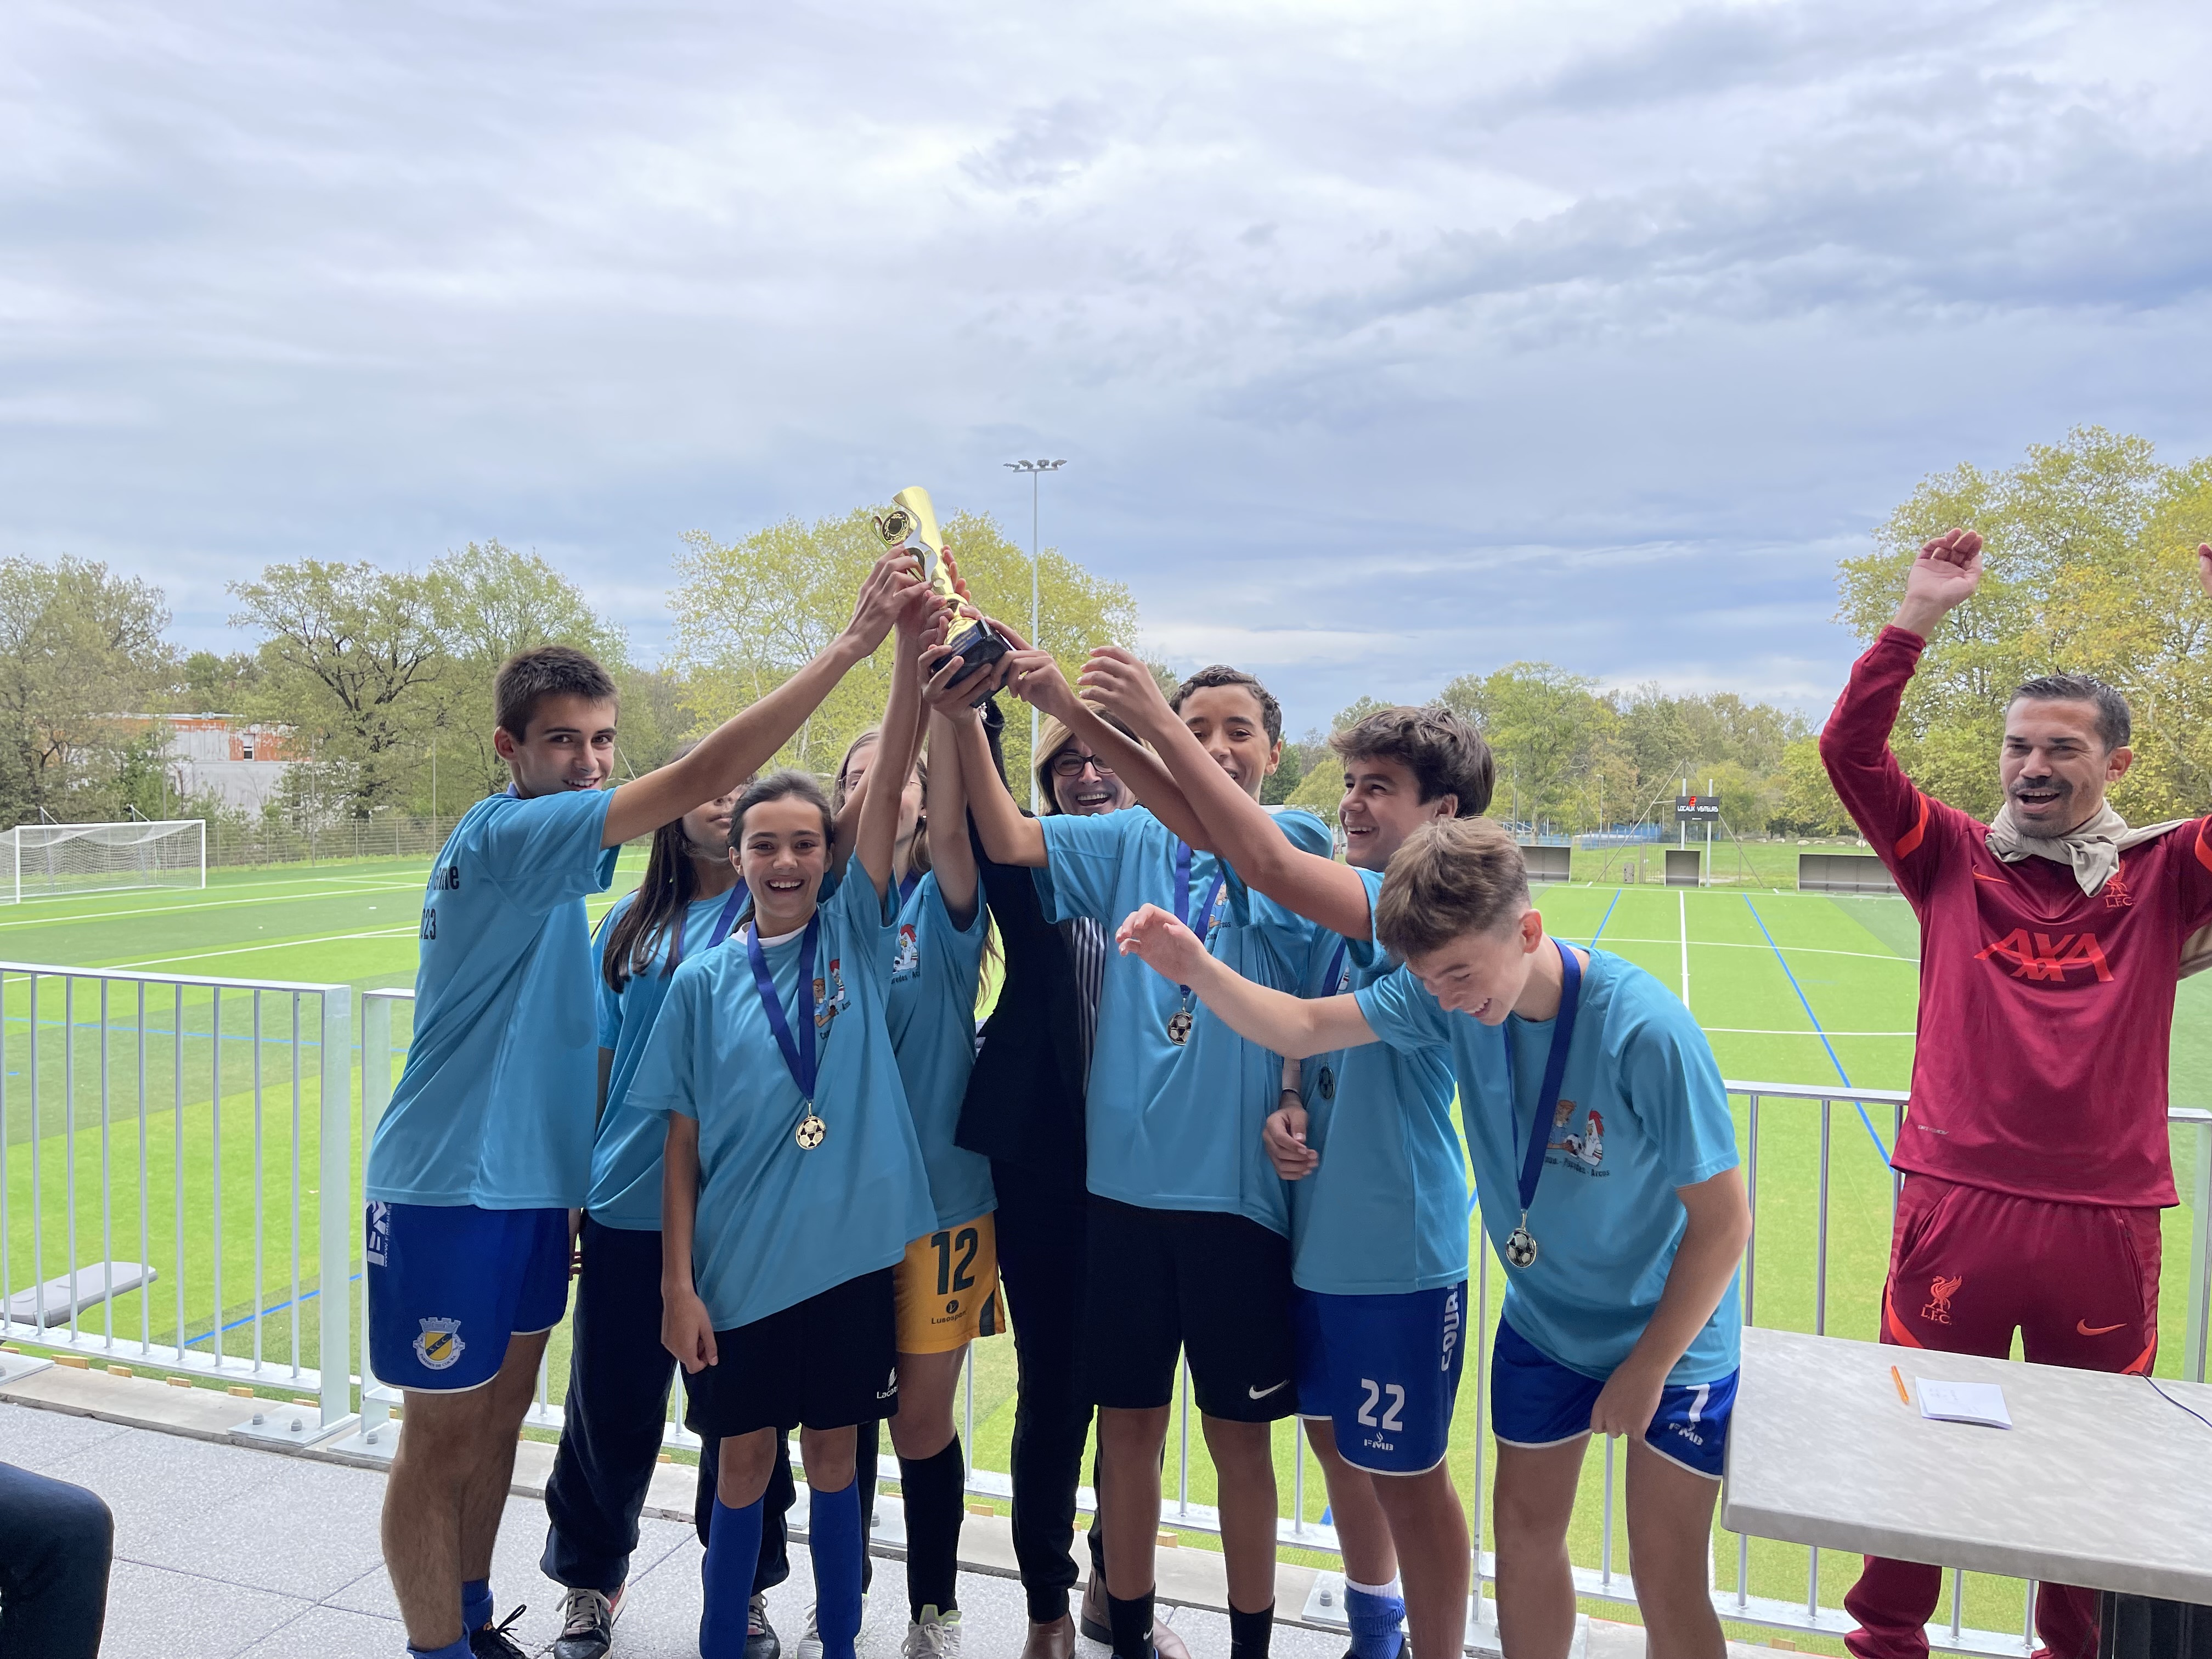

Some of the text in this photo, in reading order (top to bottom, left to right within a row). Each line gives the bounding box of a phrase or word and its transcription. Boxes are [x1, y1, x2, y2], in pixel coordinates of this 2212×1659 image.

[1973, 928, 2115, 982] AXA
[1591, 1169, 1610, 1177] Arcos
[931, 1227, 978, 1295] 12
[1358, 1378, 1405, 1431] 22
[1686, 1383, 1711, 1423] 7
